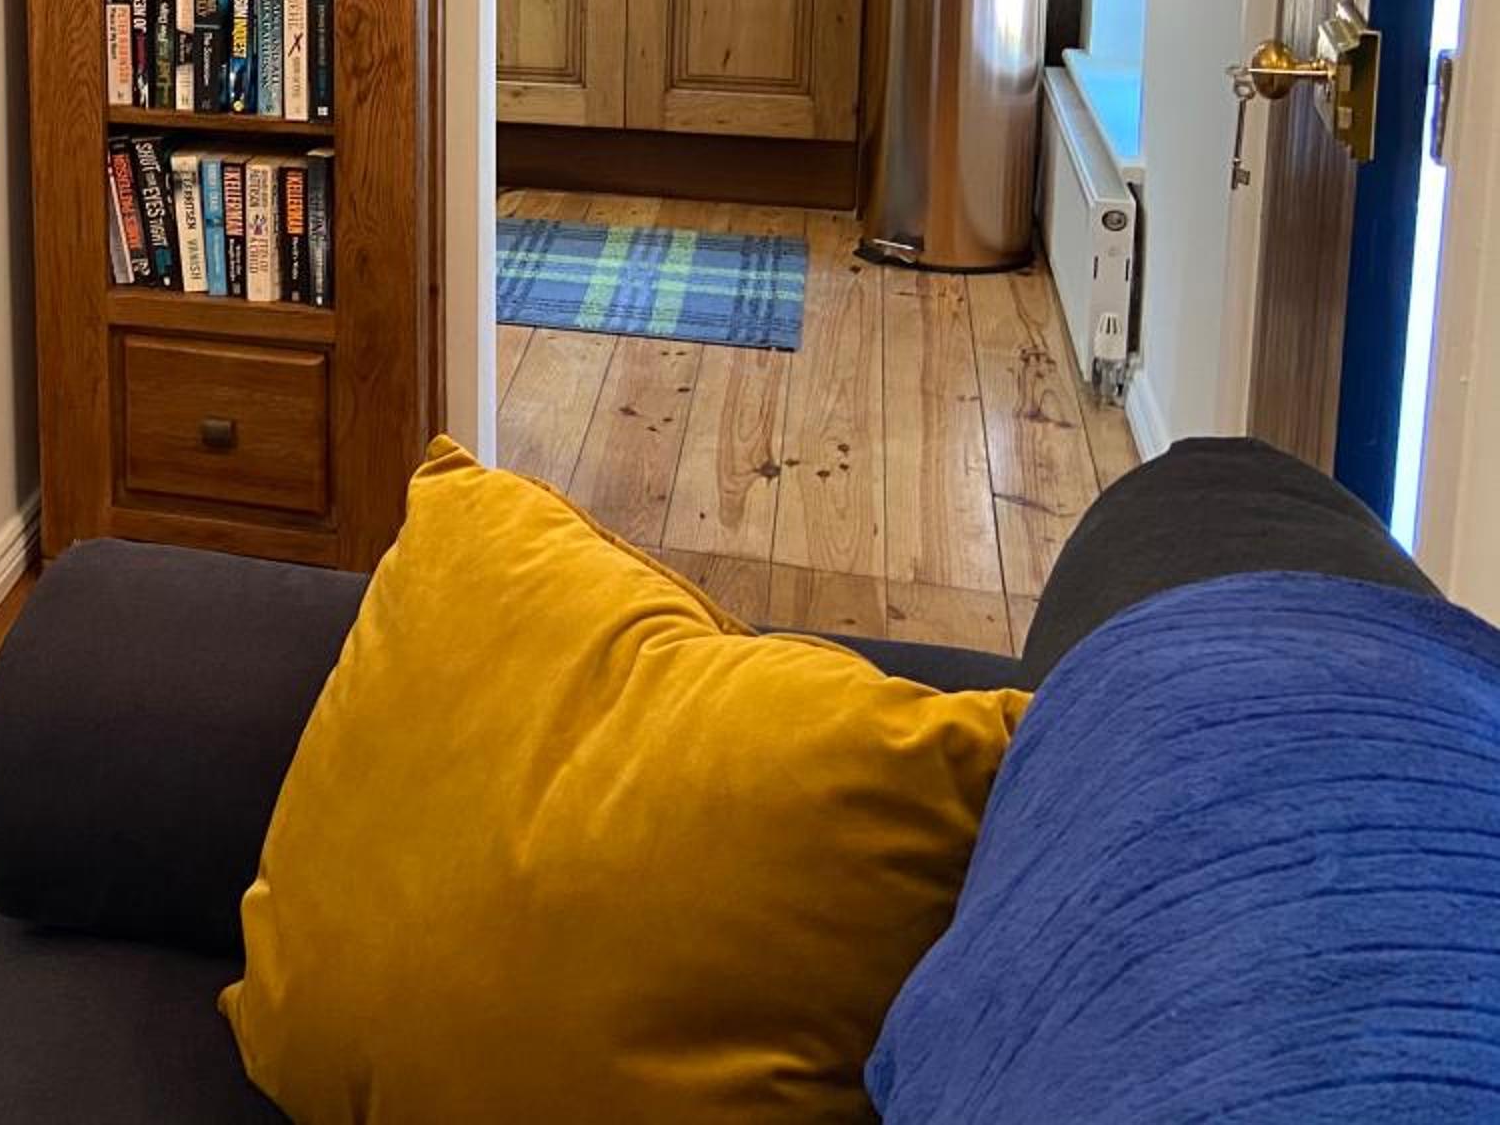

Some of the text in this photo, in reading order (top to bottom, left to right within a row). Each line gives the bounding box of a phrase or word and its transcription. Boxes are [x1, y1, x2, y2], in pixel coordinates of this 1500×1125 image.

[133, 17, 147, 33] JO
[157, 2, 169, 23] Days
[204, 32, 213, 46] The
[135, 142, 162, 173] SHUT
[141, 187, 166, 219] EYES
[249, 169, 261, 208] PATTERSON
[224, 173, 243, 236] KELLERMAN
[286, 176, 304, 234] KELLERMAN
[150, 218, 168, 247] TIGHT
[187, 239, 202, 281] VANISH
